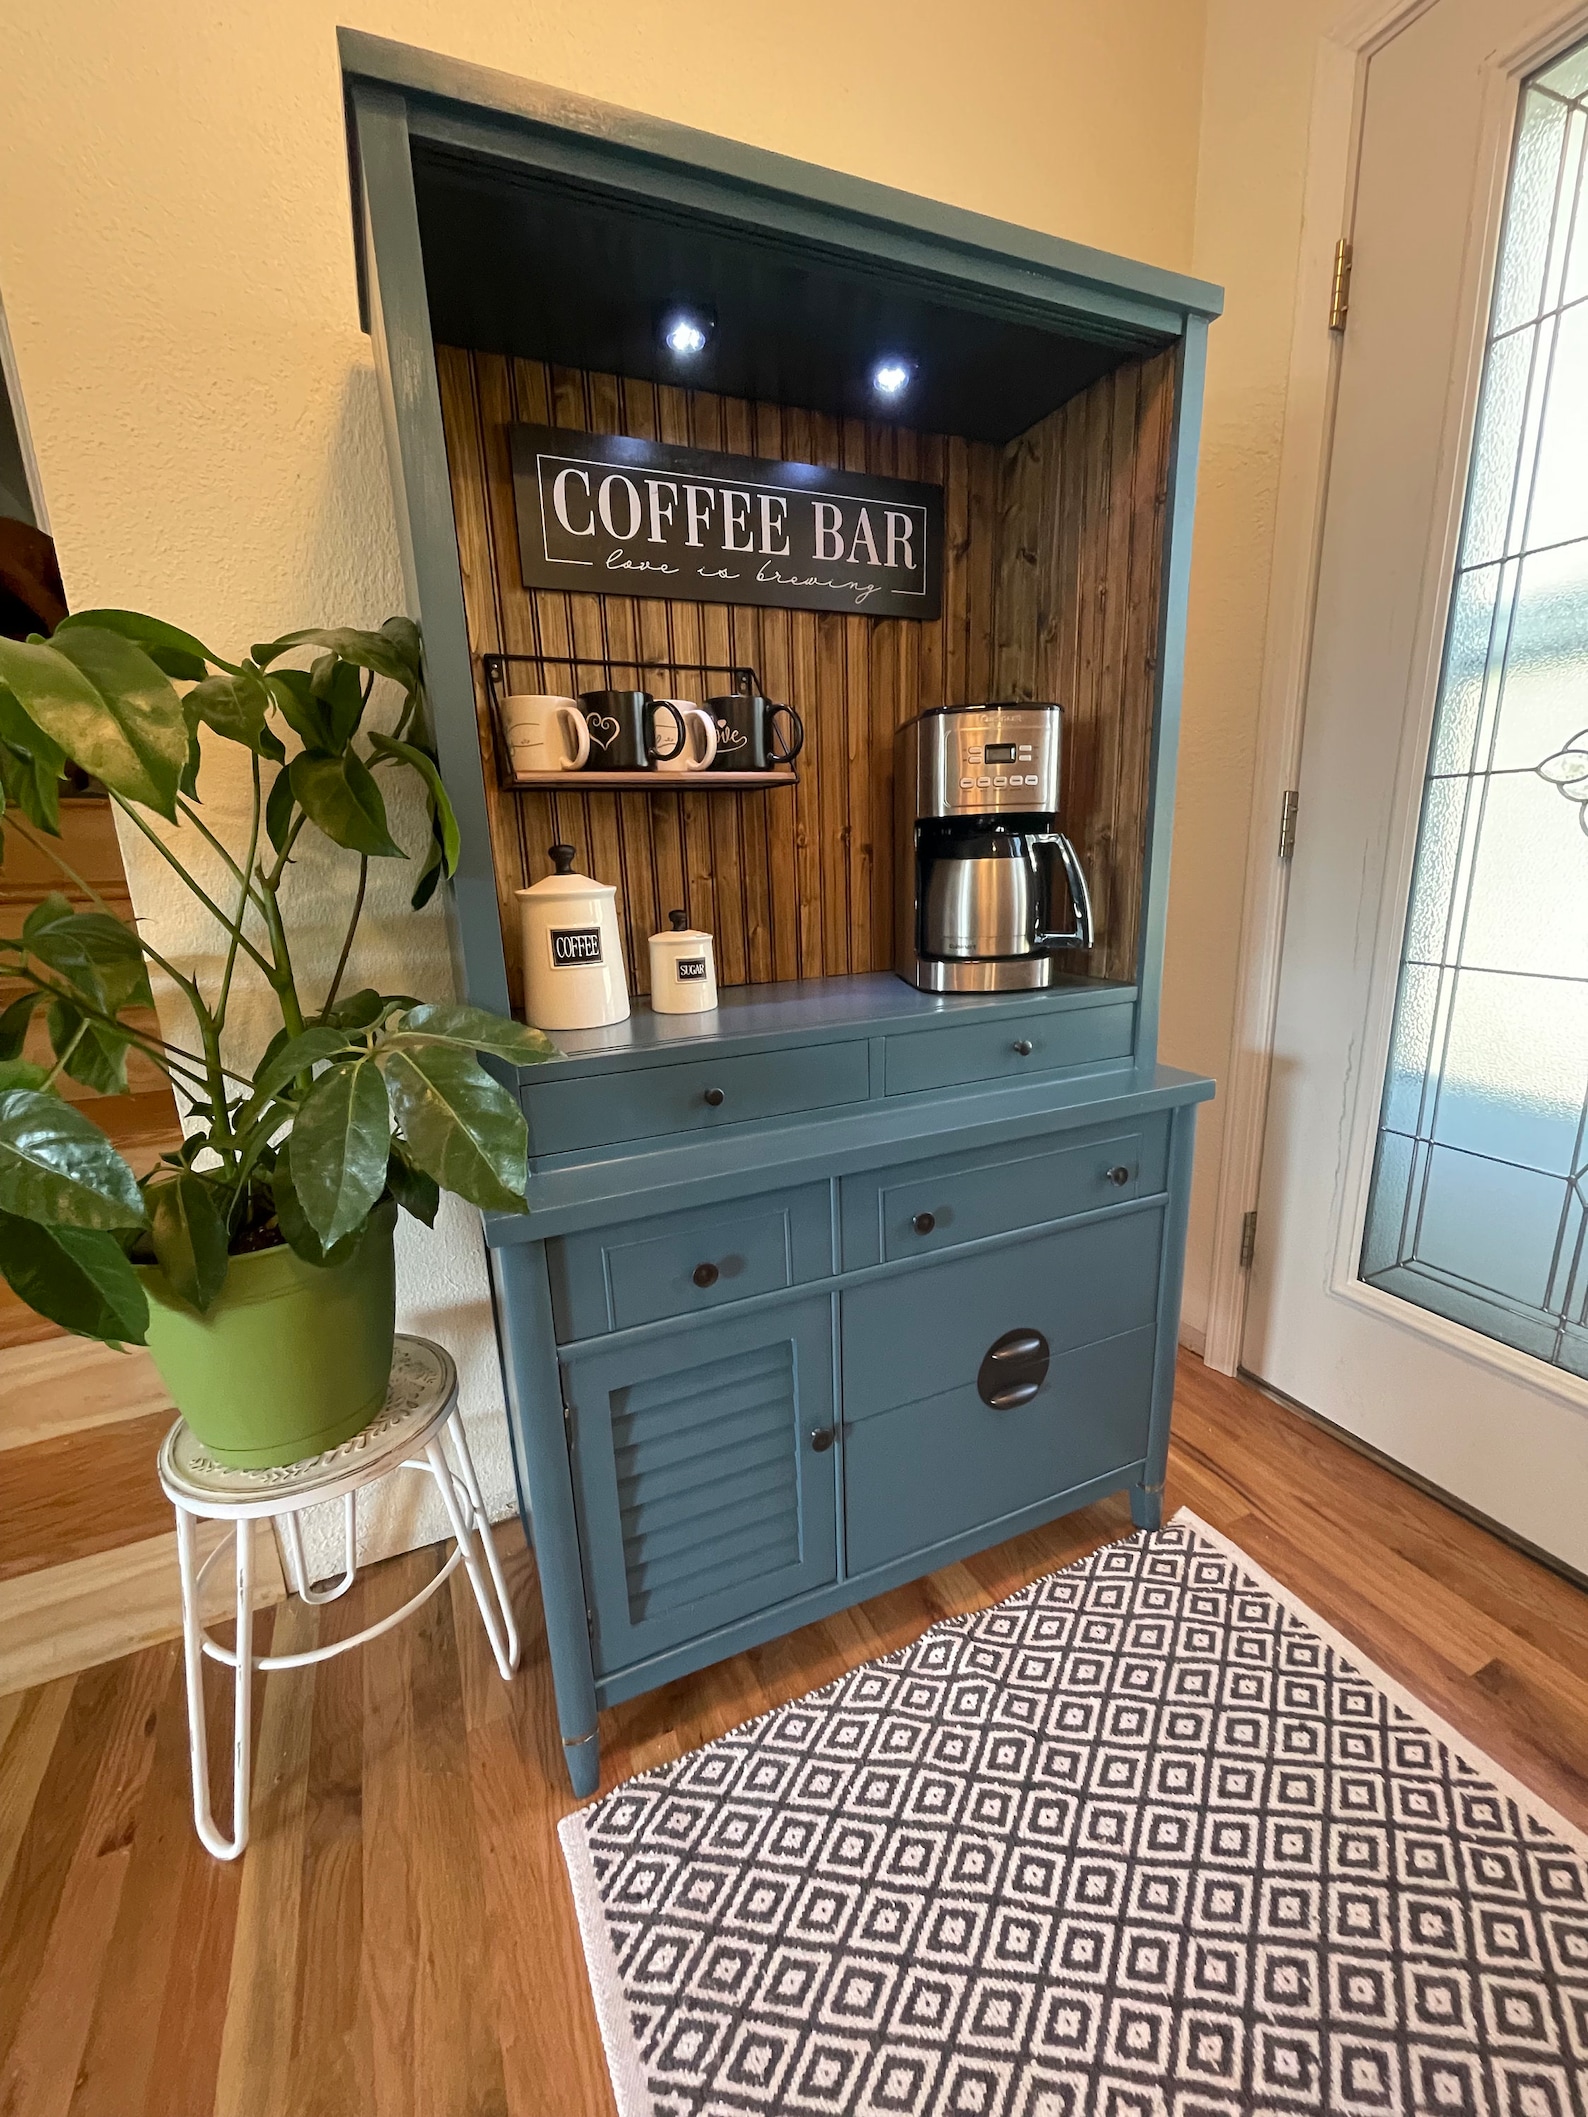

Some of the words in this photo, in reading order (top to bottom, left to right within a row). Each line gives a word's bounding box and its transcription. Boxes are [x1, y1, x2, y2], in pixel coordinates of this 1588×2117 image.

[553, 468, 790, 556] COFFEE
[811, 501, 917, 570] BAR
[605, 548, 679, 575] love
[697, 566, 740, 579] is
[756, 559, 882, 604] brewing
[556, 935, 599, 958] COFFEE
[680, 964, 705, 976] SUGAR
